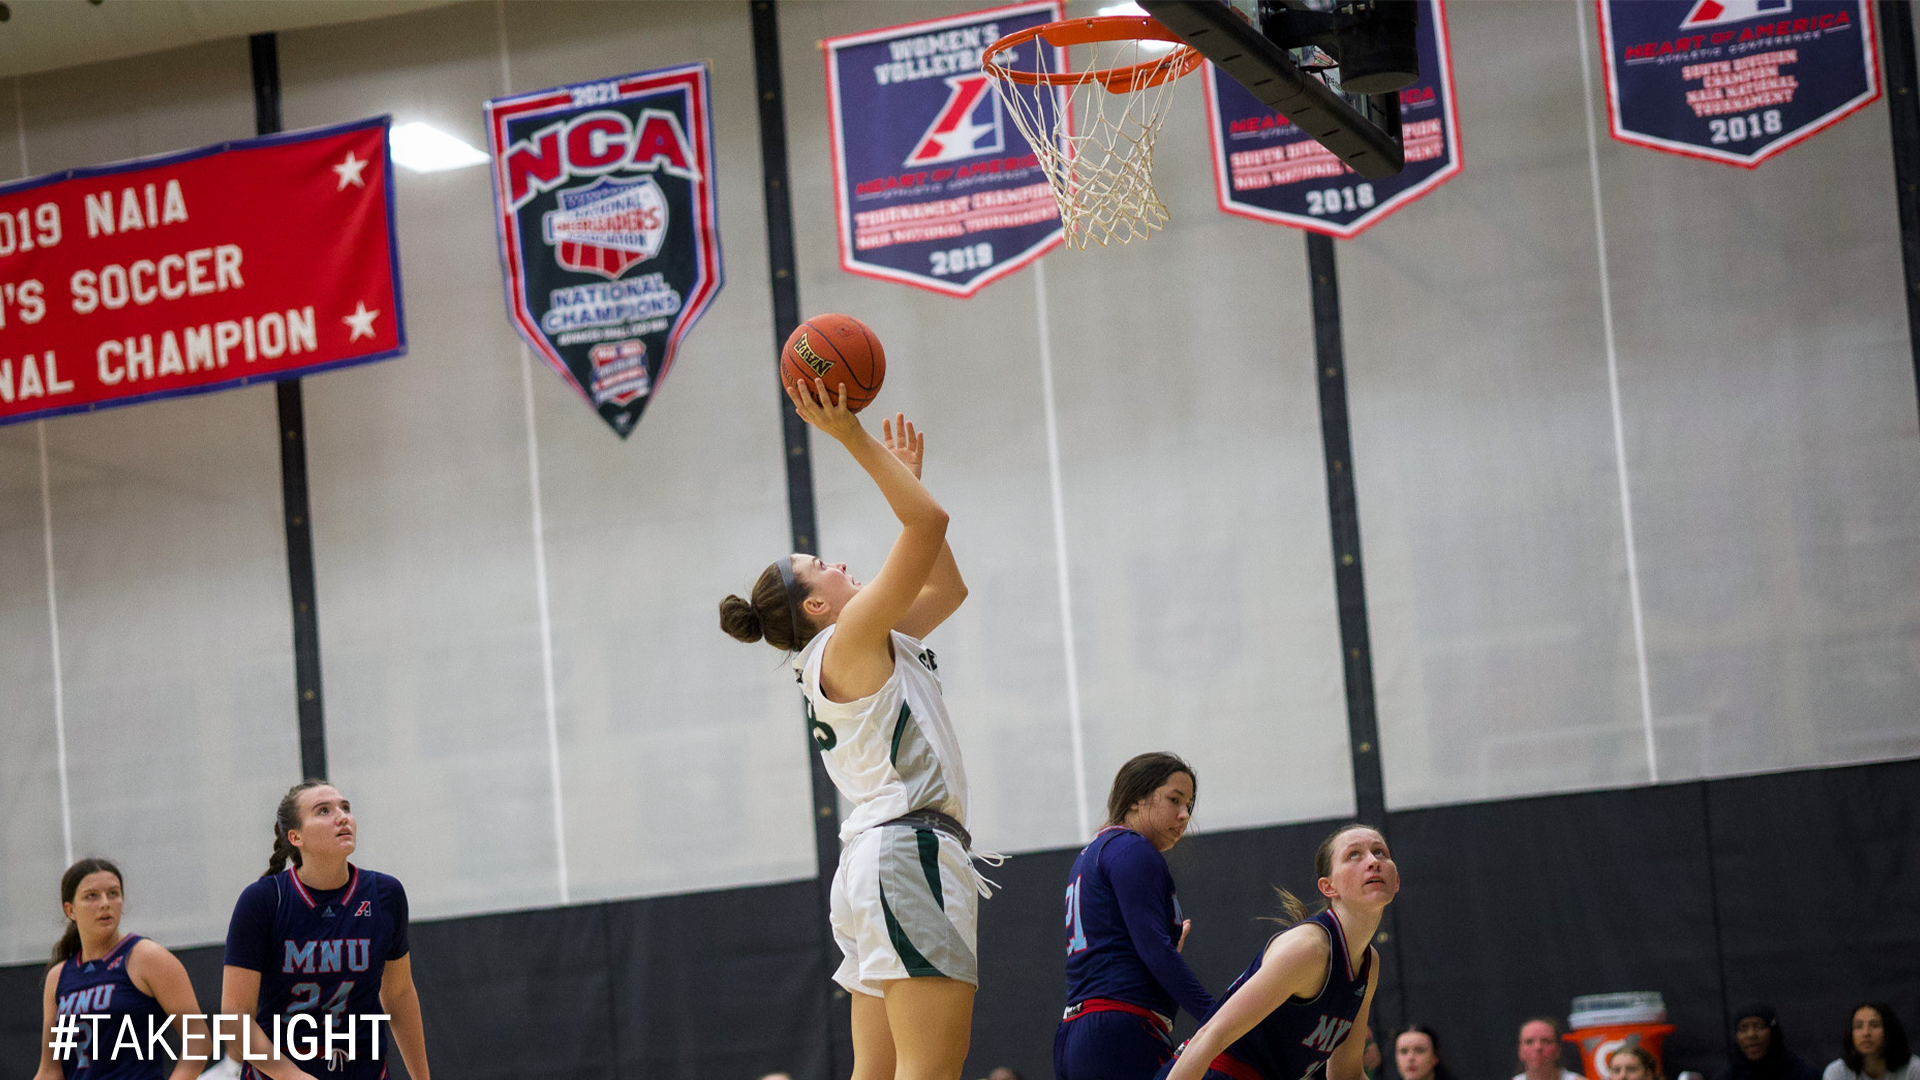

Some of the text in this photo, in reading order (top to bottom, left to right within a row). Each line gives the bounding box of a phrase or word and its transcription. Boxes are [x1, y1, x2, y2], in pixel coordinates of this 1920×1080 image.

[889, 22, 1000, 61] WOMEN'S
[1625, 10, 1850, 60] HEART OF AMERICA
[1655, 32, 1822, 66] ATHLETIC CONFERENCE
[874, 46, 1019, 85] VOLLEYBAL
[1682, 60, 1732, 81] SOUTH
[1703, 64, 1779, 89] CHAMPION
[1724, 75, 1799, 99] NATIONAL
[1708, 109, 1782, 144] 2018
[502, 108, 702, 212] NCA
[856, 171, 929, 196] HEART
[931, 168, 955, 182] OF
[1305, 183, 1376, 216] 2018
[84, 178, 189, 239] NAIA
[929, 243, 994, 276] 2019
[70, 243, 245, 316] SOCCER
[556, 278, 668, 307] NATIONAL
[547, 295, 677, 329] CHAMPIONS
[96, 305, 318, 386] CHAMPION
[793, 332, 836, 378] NAIA
[282, 938, 371, 974] MNU
[55, 984, 116, 1023] MNU
[281, 981, 355, 1028] 24
